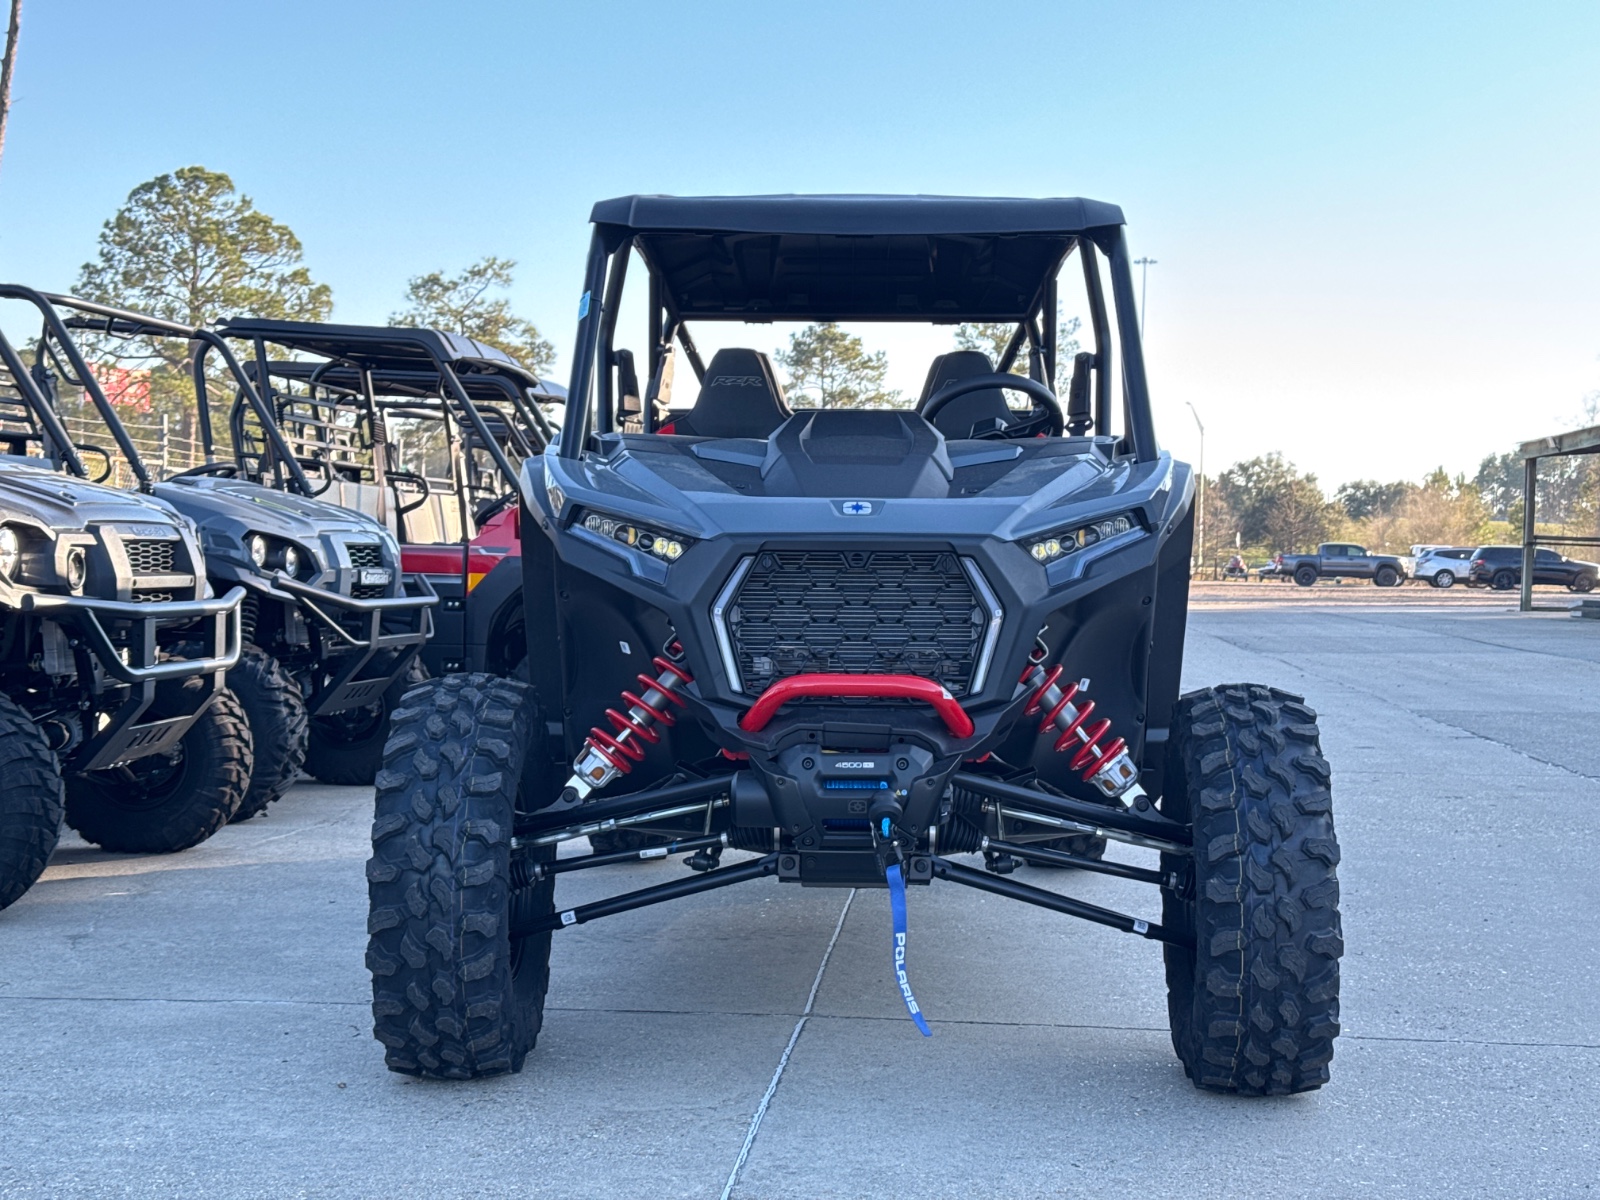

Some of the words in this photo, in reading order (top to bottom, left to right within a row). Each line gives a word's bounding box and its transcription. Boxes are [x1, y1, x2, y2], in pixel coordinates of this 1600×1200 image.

[711, 375, 762, 387] RZR
[835, 761, 863, 769] 4500
[895, 932, 920, 1014] POLARIS
